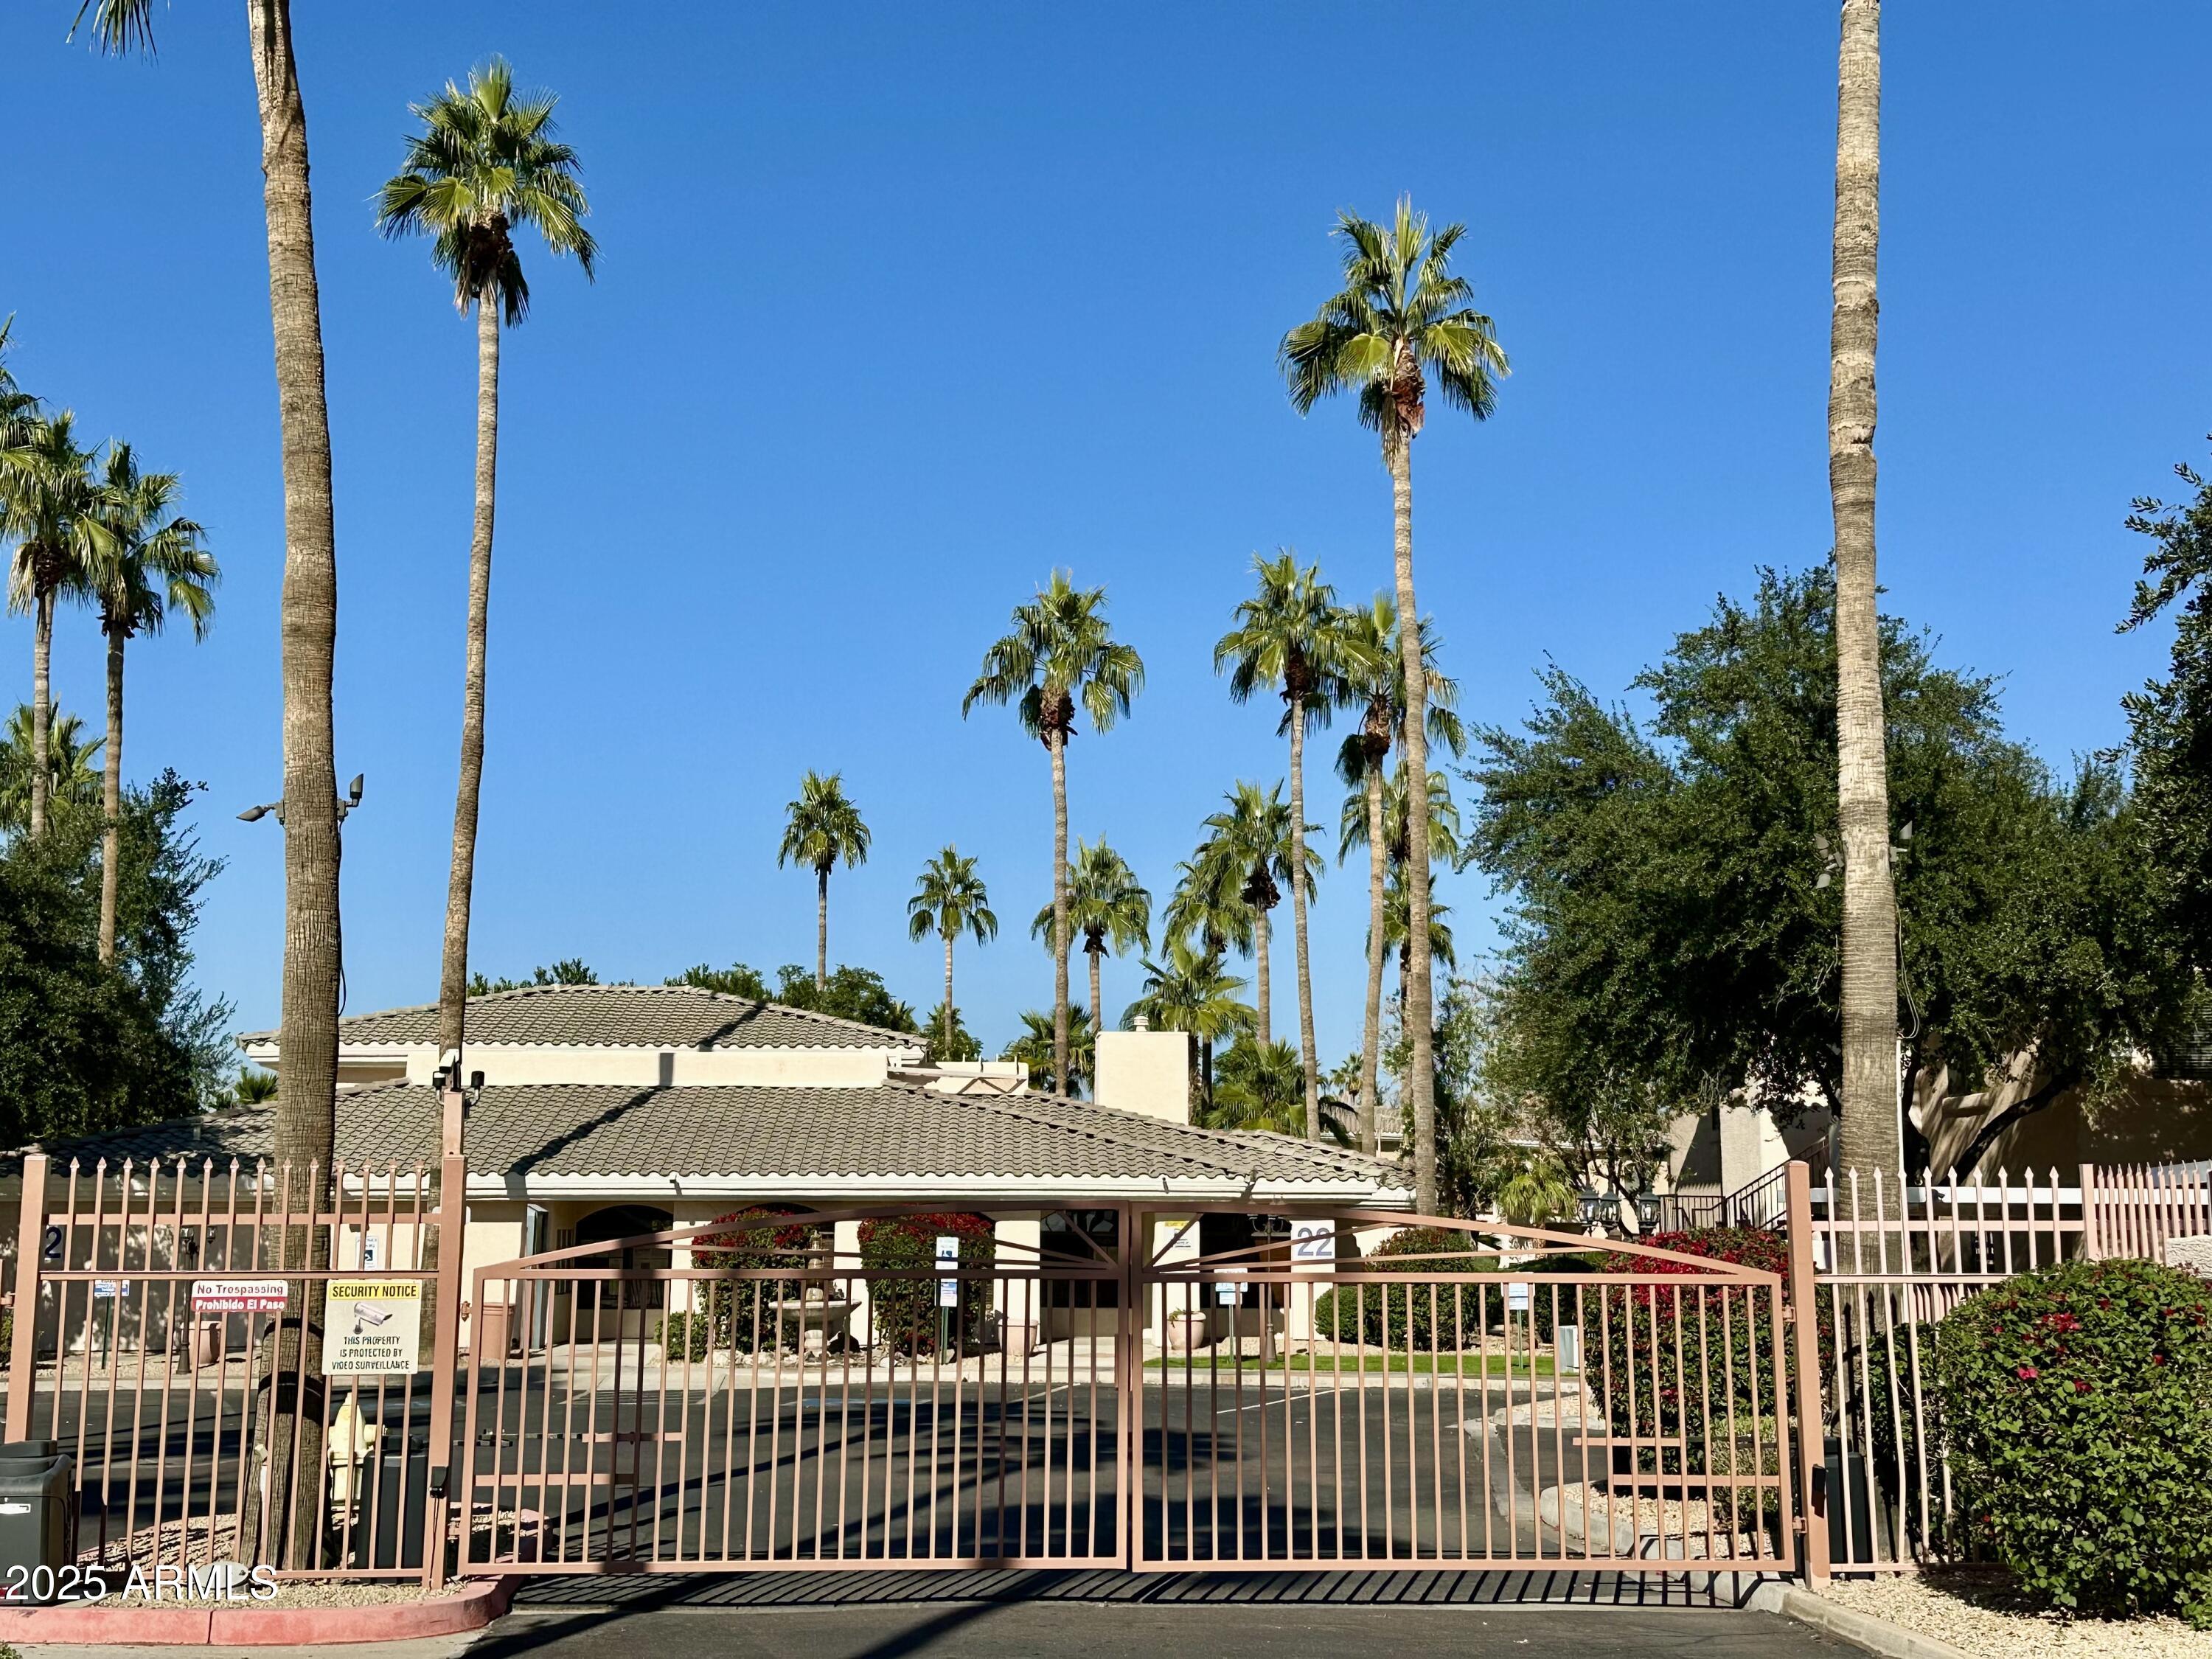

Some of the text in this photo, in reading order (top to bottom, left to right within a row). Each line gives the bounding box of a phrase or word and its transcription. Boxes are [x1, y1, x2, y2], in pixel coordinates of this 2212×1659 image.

[1298, 1227, 1332, 1256] 22
[197, 1284, 212, 1294] No
[332, 1285, 417, 1298] SECURITY NOTICE
[195, 1298, 285, 1310] Prohibido El Paso
[344, 1336, 400, 1345] THIS PROPERTY
[340, 1348, 403, 1357] IS PROTECTED BY
[332, 1360, 410, 1370] VIDEO SURVEILLANCE
